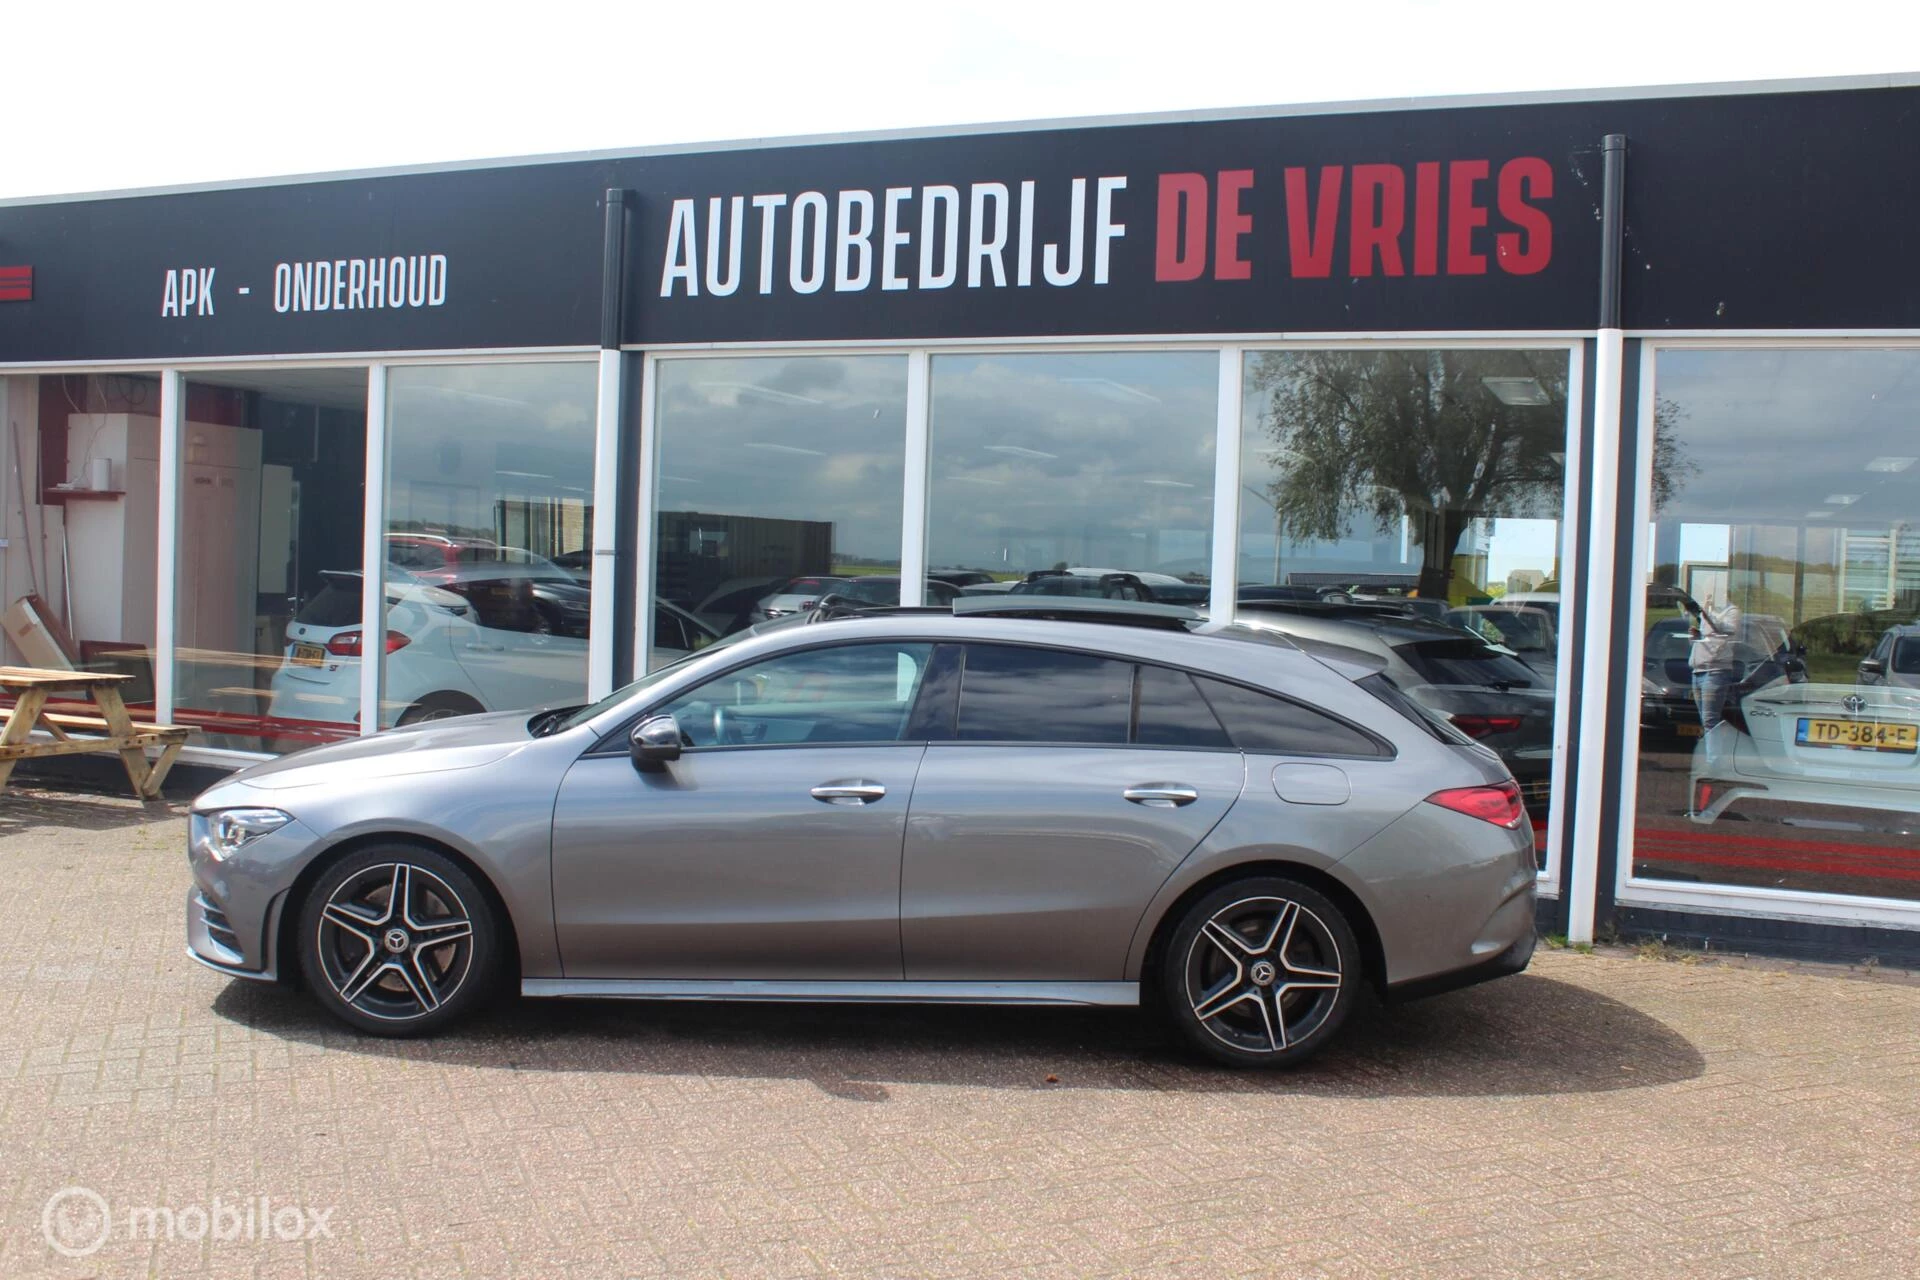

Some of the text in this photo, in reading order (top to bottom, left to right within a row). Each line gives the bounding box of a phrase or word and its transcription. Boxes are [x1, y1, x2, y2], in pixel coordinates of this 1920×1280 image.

[660, 156, 1553, 297] AUTOBEDRIJF DE VRIES
[161, 267, 216, 317] APK
[274, 254, 447, 313] ONDERHOUD
